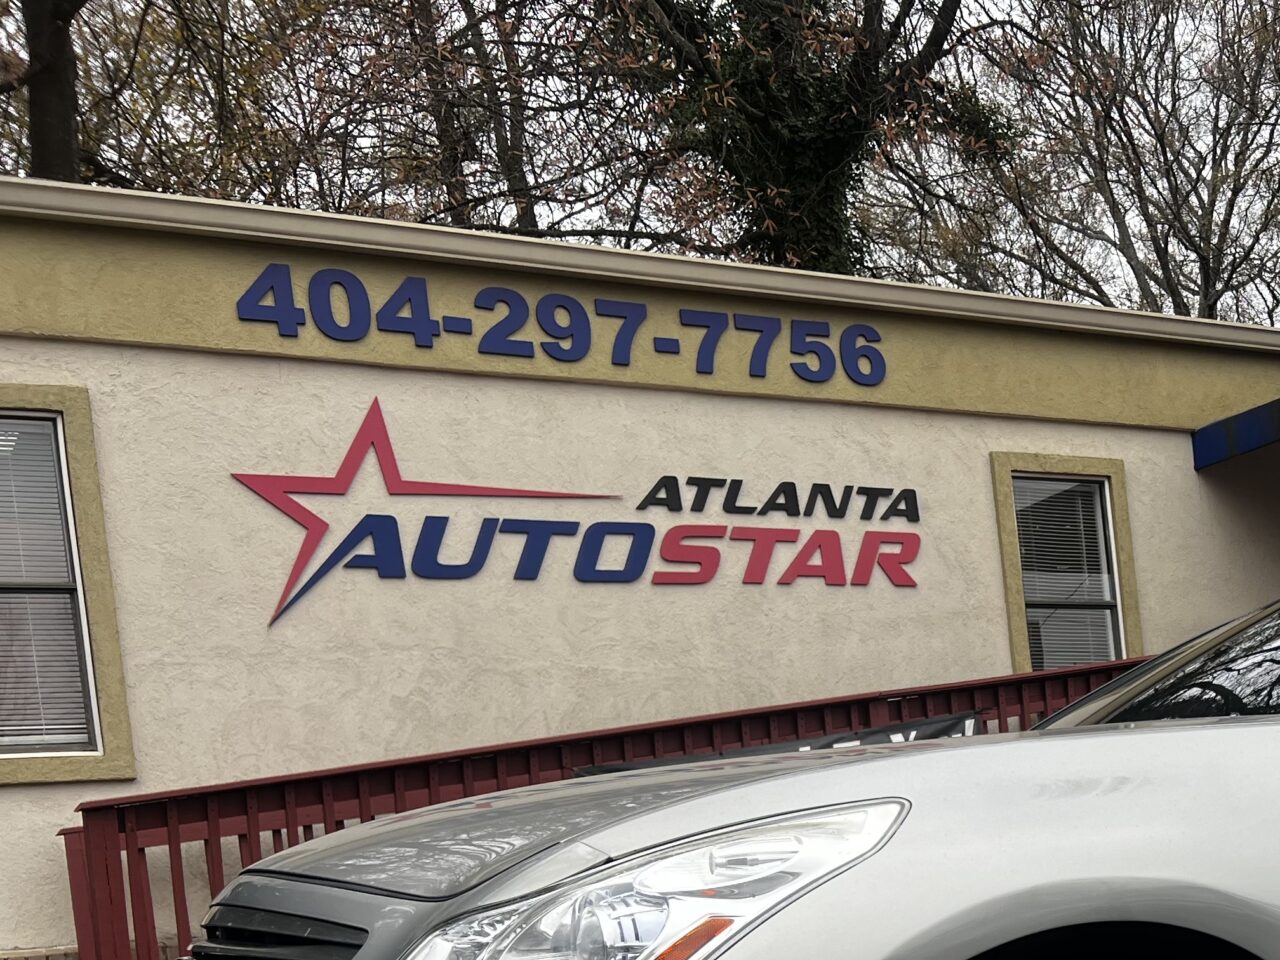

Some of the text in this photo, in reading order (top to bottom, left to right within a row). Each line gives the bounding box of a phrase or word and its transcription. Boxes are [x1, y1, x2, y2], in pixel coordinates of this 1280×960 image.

[236, 262, 888, 388] 404-297-7756
[635, 475, 922, 523] ATLANTA
[335, 512, 922, 590] AUTOSTAR
